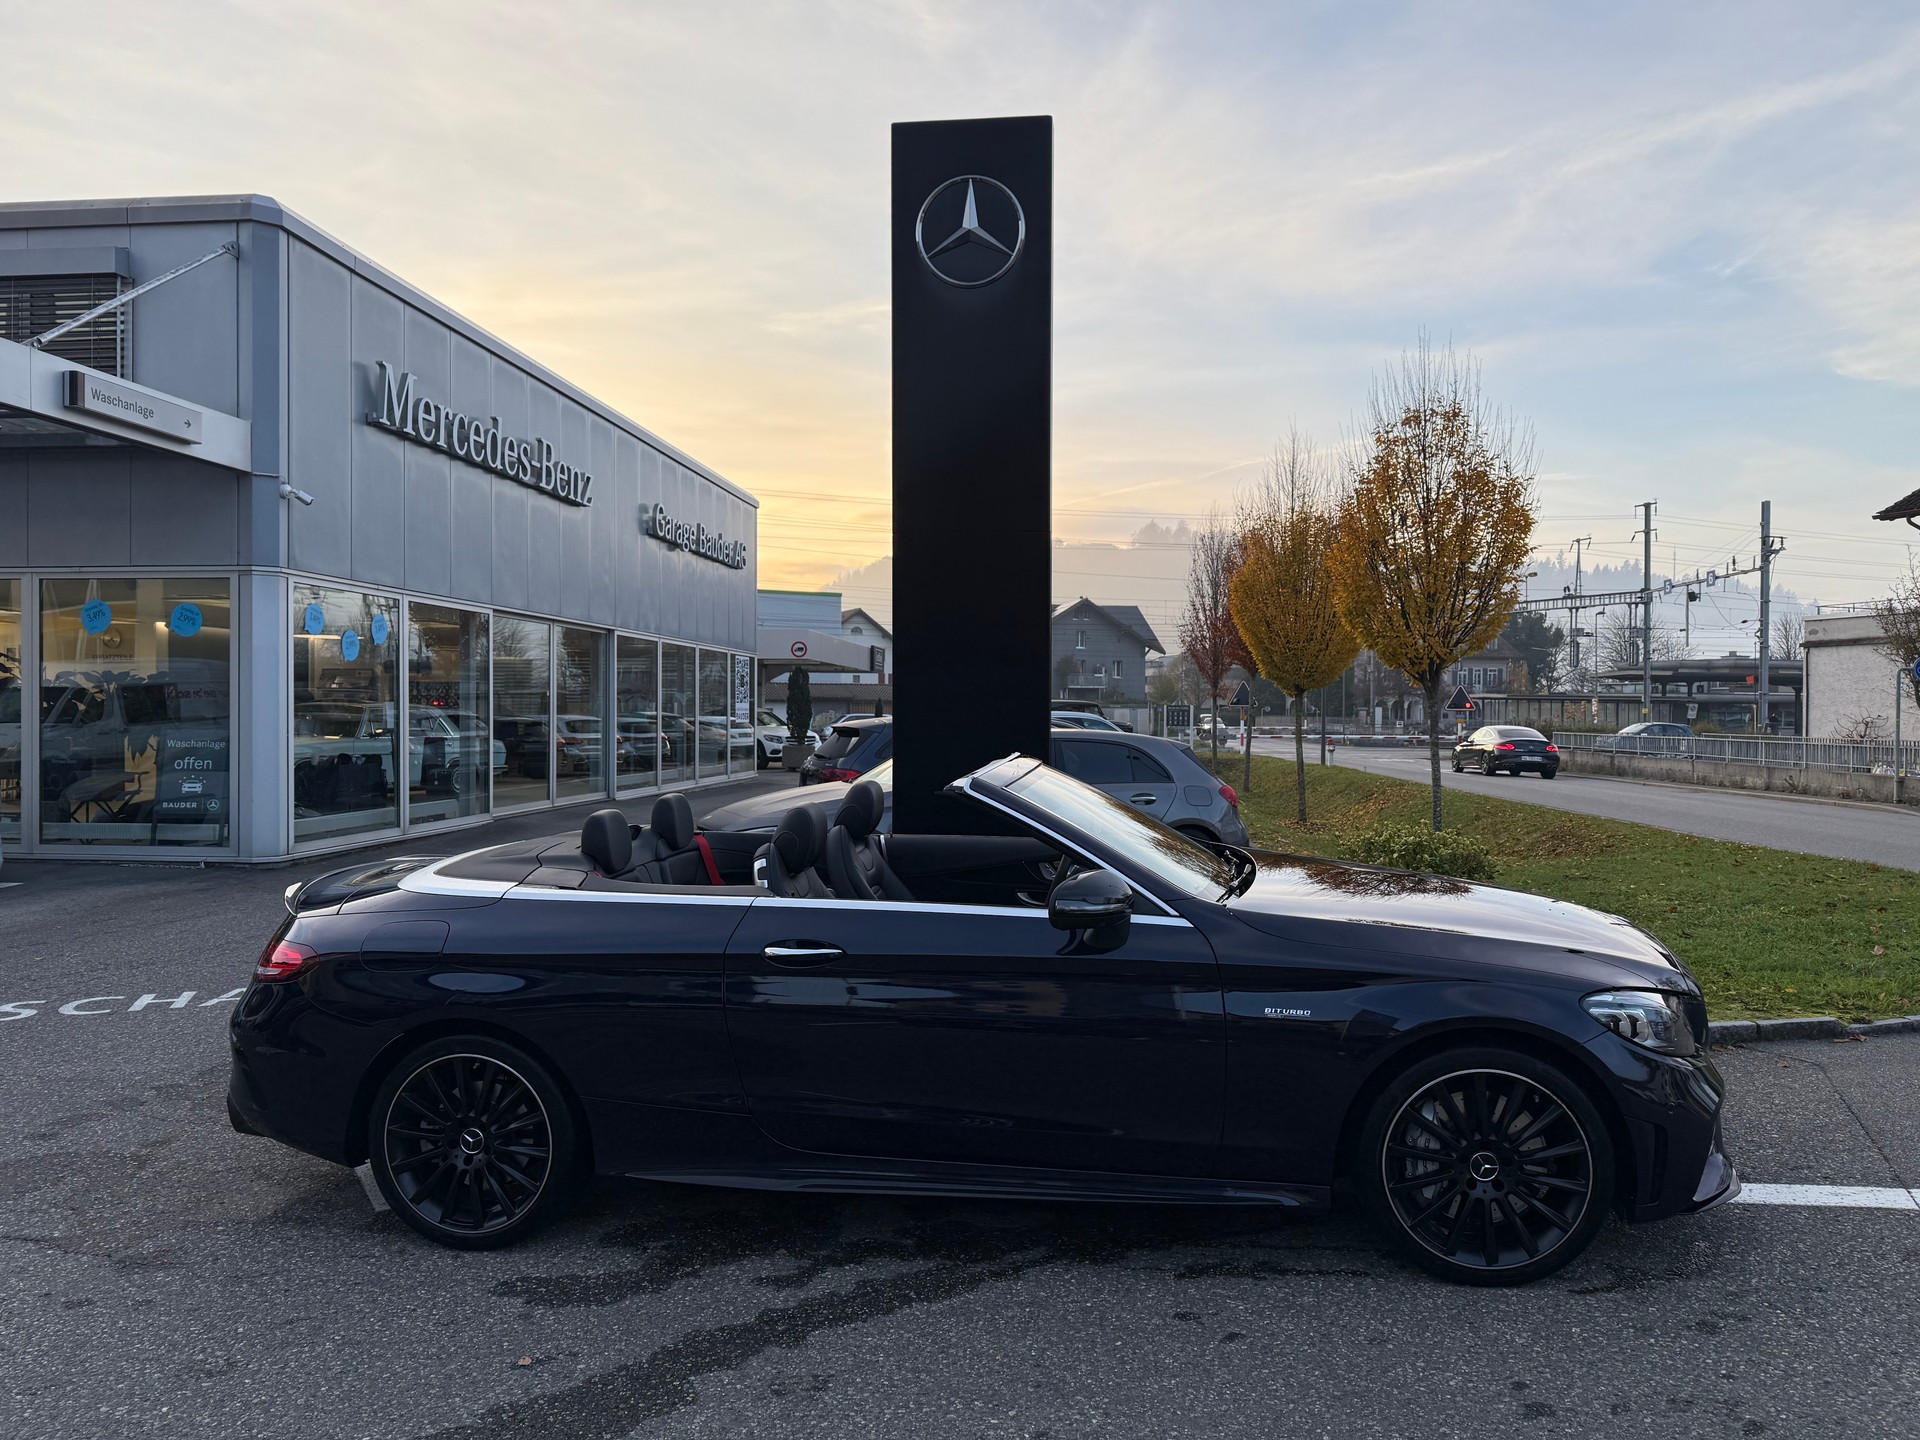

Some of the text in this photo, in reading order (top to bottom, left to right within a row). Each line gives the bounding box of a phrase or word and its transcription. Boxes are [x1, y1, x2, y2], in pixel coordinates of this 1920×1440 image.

[90, 386, 155, 419] Waschanlage
[375, 360, 594, 508] Mercedes-Benz
[653, 502, 747, 569] Garage Bauder AG
[166, 739, 226, 749] Waschanlage
[174, 756, 213, 770] offen
[1264, 1007, 1312, 1016] BITURBO
